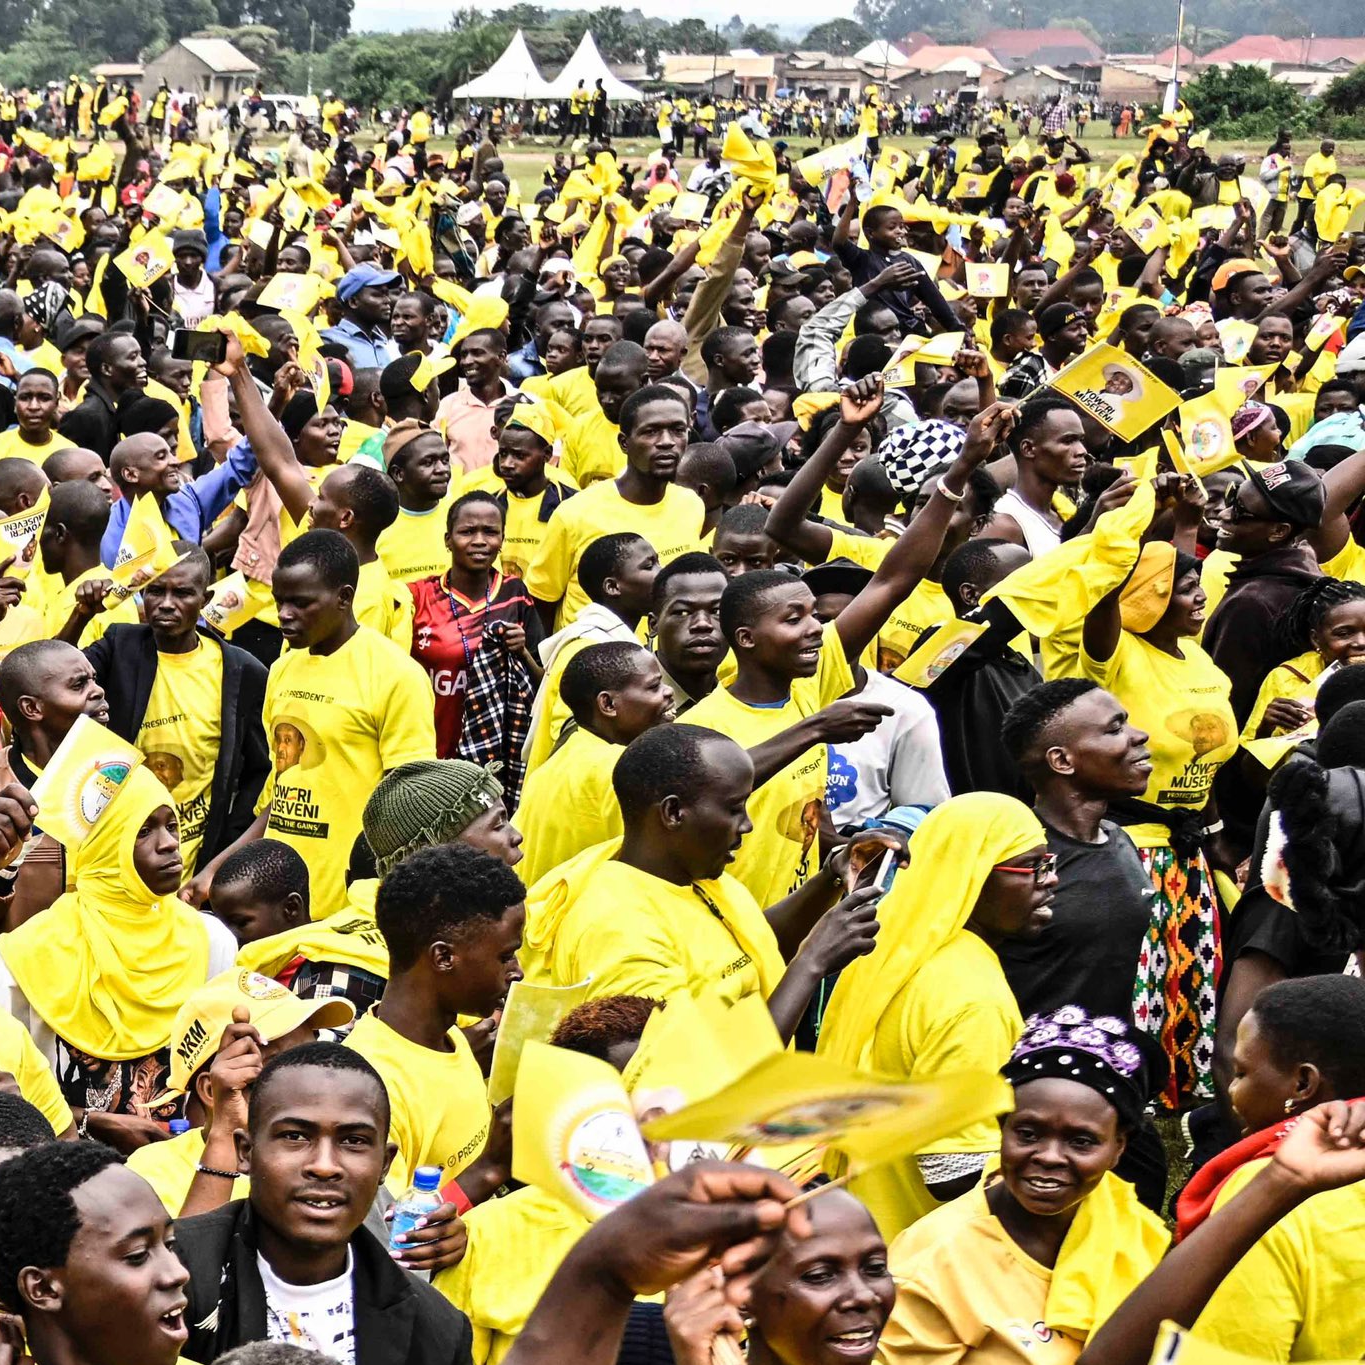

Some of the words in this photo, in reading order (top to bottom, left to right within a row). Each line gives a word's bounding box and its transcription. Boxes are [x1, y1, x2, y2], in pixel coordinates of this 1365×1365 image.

[1073, 390, 1113, 423] MUSEVENI
[1083, 388, 1116, 414] YOWERI
[659, 546, 684, 556] SIDENT
[400, 565, 438, 576] PRESIDENT
[896, 620, 924, 635] PRESID
[140, 714, 183, 731] PRESIDENT
[1171, 775, 1212, 789] MUSEV
[273, 785, 313, 804] OWERI
[272, 801, 320, 819] USEVENI
[177, 1018, 208, 1061] NRM
[457, 1123, 488, 1164] PRESIDENT
